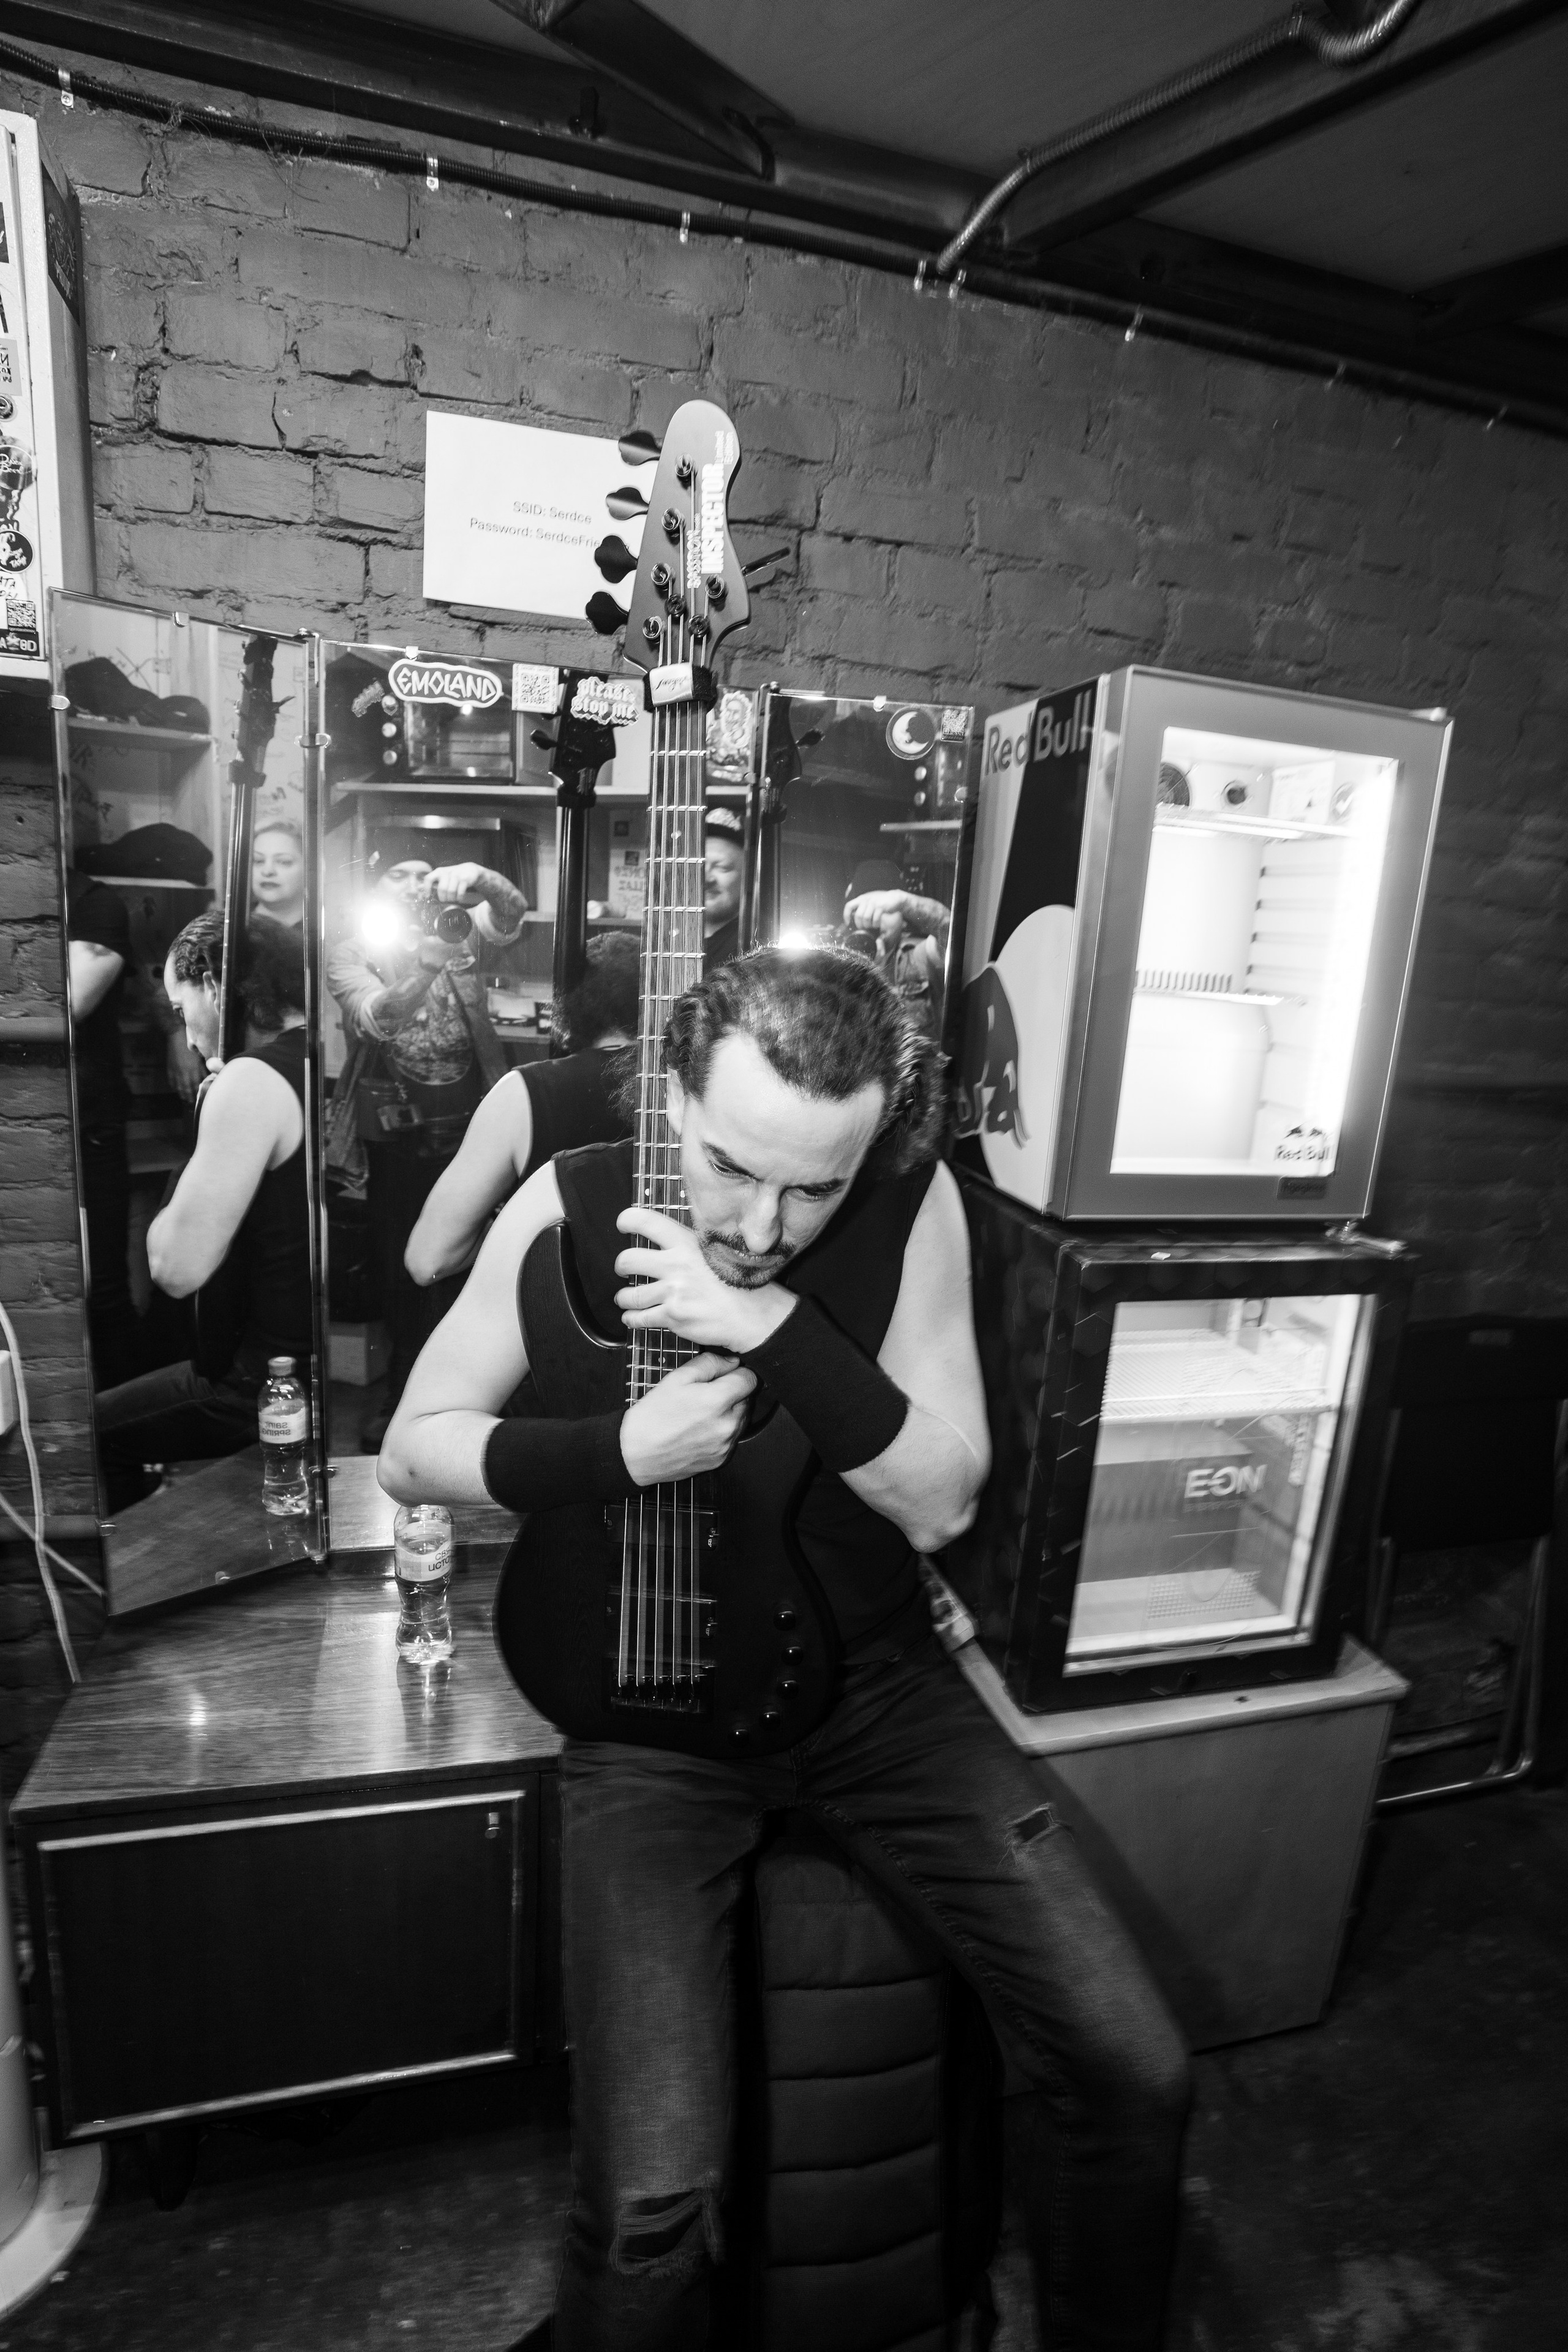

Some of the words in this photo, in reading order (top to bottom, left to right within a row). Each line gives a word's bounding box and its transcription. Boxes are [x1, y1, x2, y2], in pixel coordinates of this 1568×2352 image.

[513, 500, 546, 518] SSID:
[549, 506, 592, 525] Serdce
[701, 463, 725, 574] INSPECTOR
[470, 517, 533, 538] Password:
[536, 527, 630, 551] SerdceFrie
[397, 666, 497, 701] EMOLAND
[984, 710, 1033, 776] Red
[1033, 688, 1093, 763] Bull
